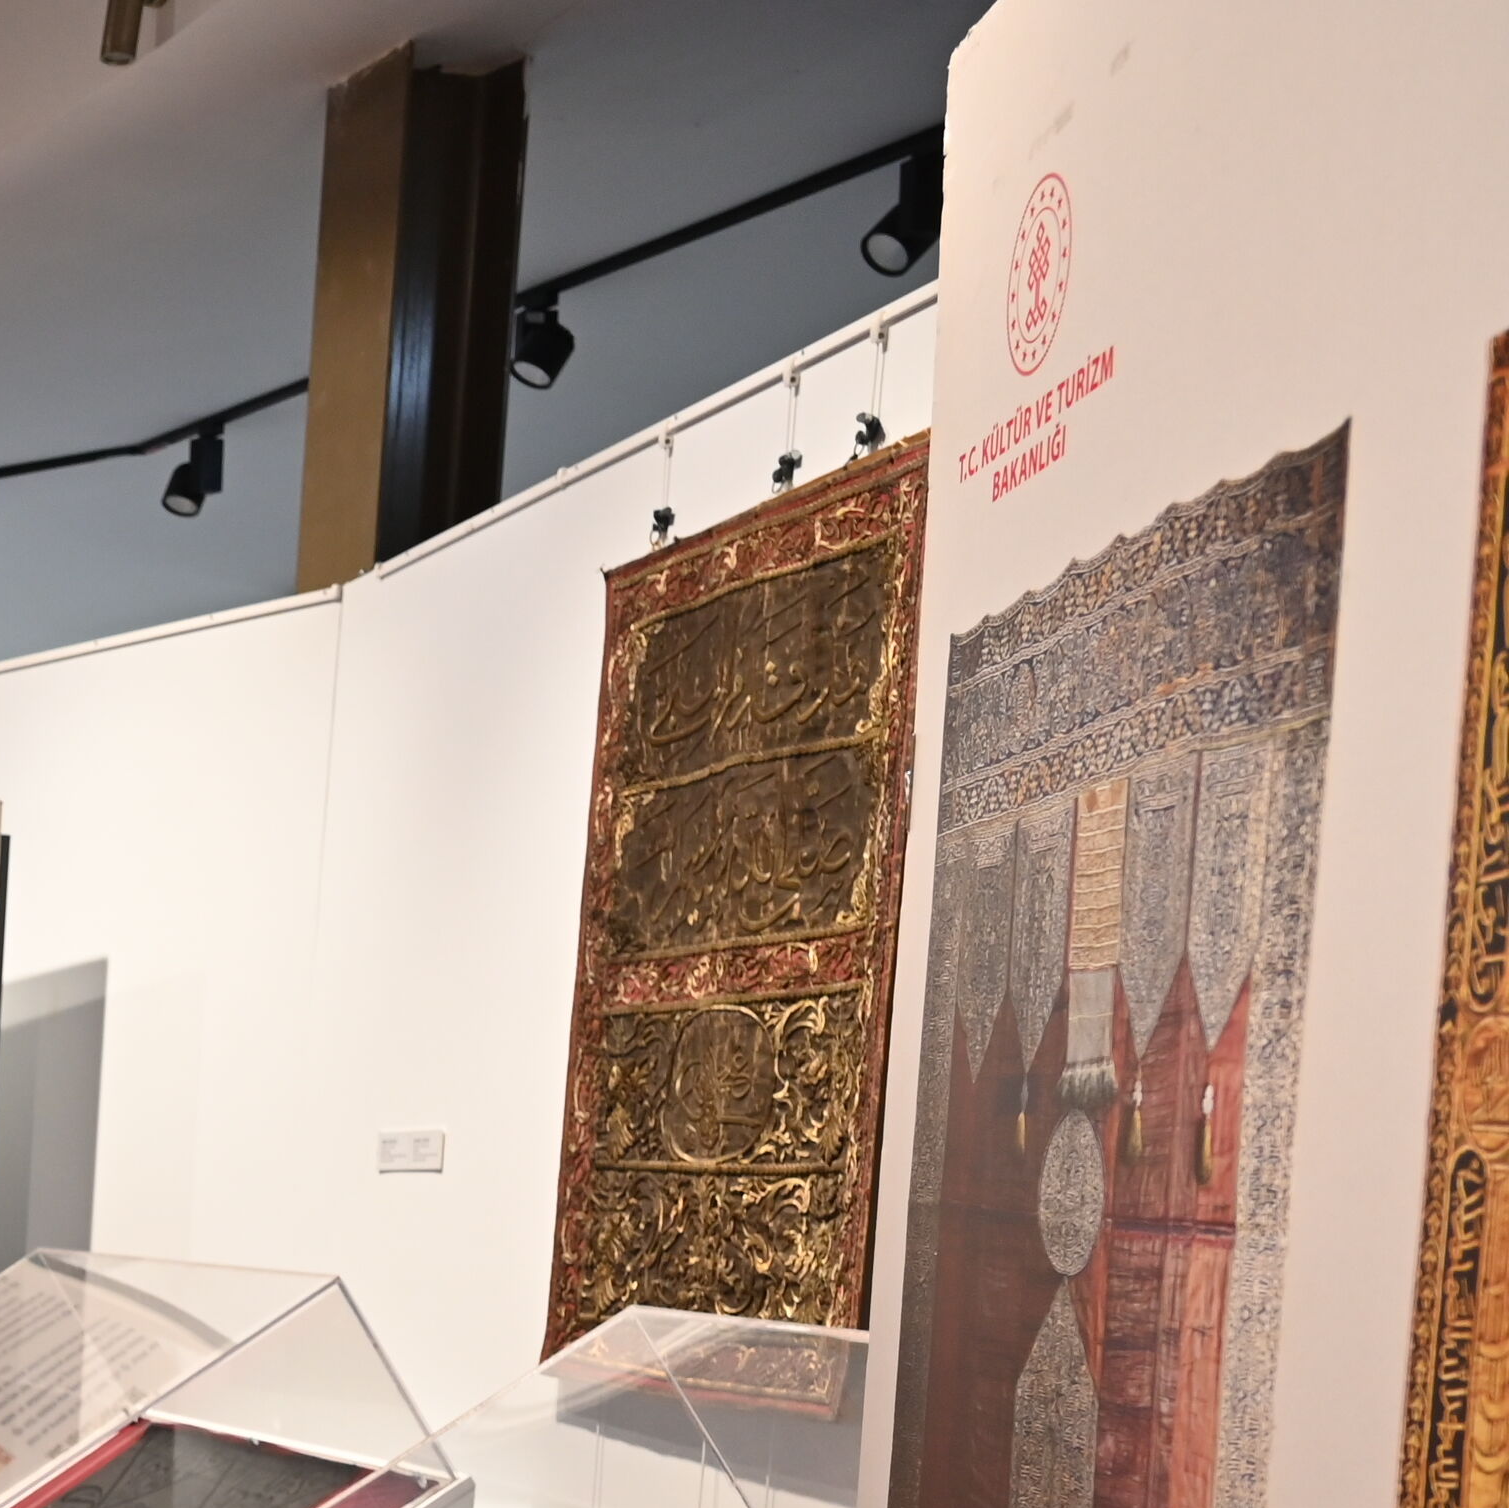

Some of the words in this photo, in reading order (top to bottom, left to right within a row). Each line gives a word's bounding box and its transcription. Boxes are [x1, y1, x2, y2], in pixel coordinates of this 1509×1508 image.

[959, 446, 979, 484] T.C.
[981, 404, 1032, 469] KÜLTÜR
[1036, 388, 1053, 430] VE
[1057, 345, 1115, 415] TURİZM
[992, 421, 1067, 503] BAKANLIĞI
